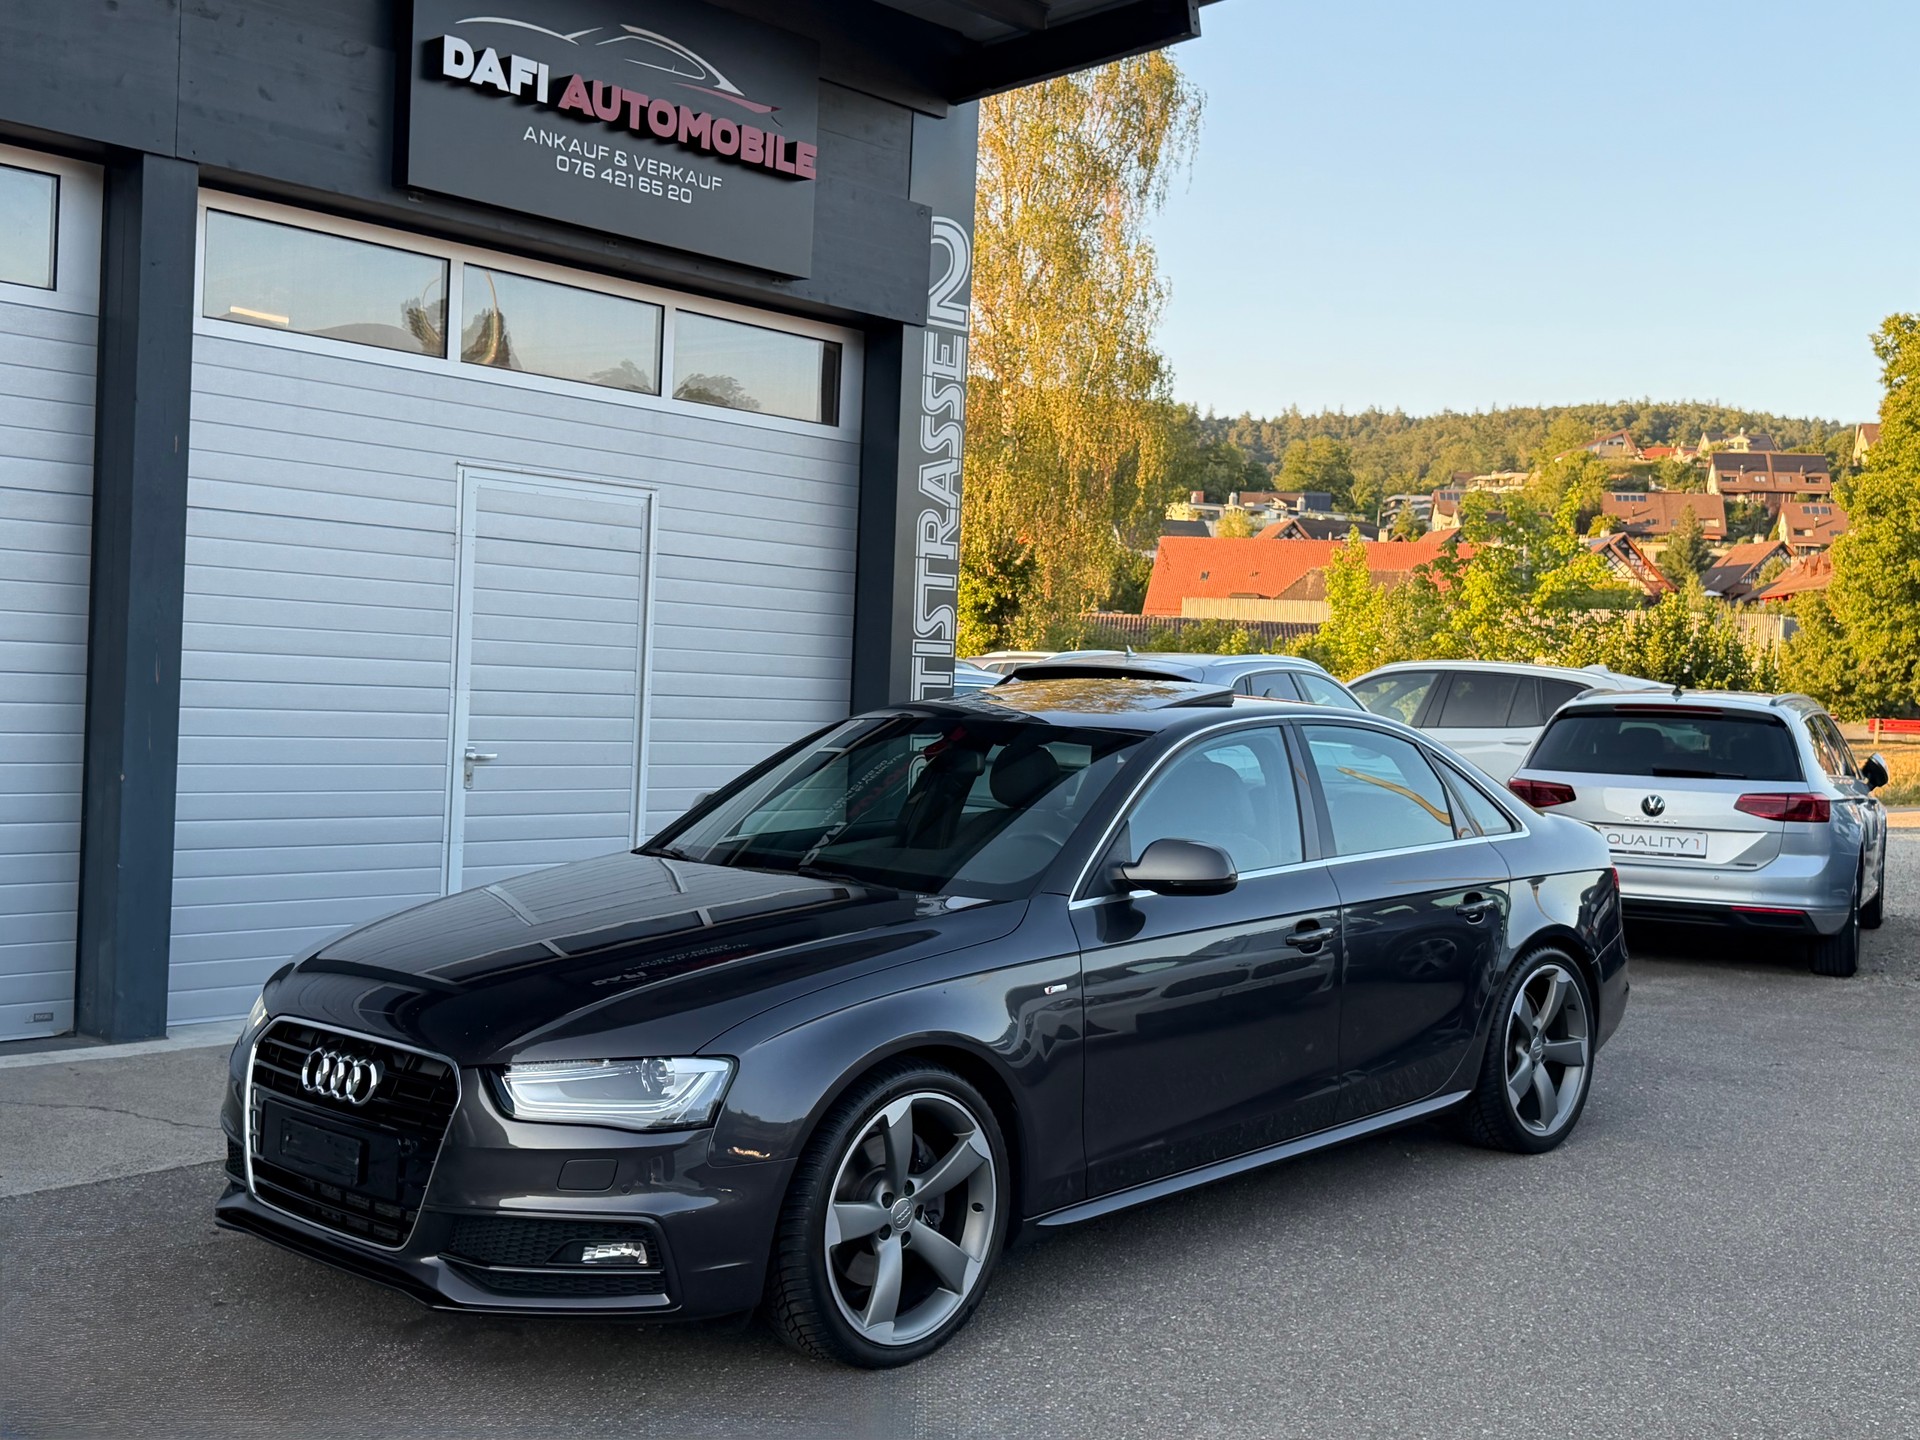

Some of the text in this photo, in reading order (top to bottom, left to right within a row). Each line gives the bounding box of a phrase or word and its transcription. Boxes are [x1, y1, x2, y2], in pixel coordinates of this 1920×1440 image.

[443, 34, 817, 180] DAFI AUTOMOBILE
[523, 126, 723, 191] ANKAUF & VERKAUF
[556, 155, 693, 204] 076 421 65 20
[927, 215, 973, 332] 2
[1606, 833, 1700, 850] QUALITY 1
